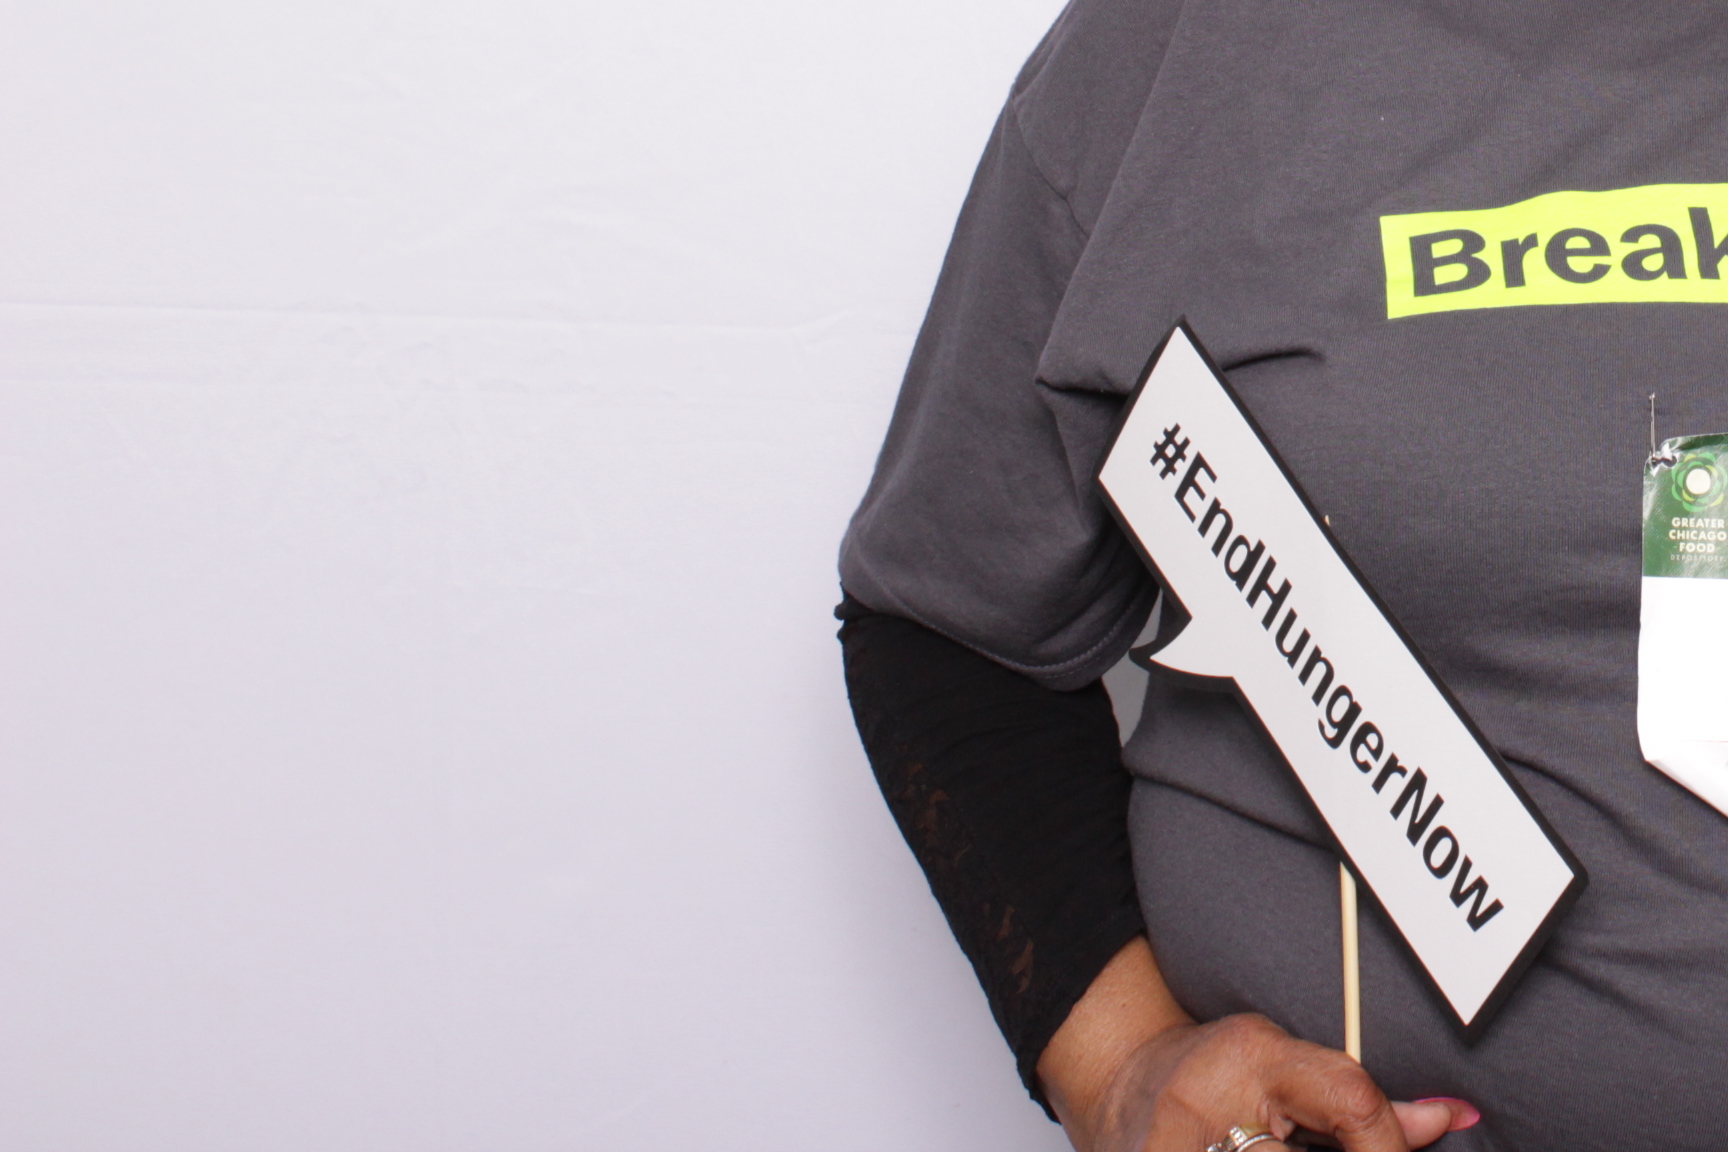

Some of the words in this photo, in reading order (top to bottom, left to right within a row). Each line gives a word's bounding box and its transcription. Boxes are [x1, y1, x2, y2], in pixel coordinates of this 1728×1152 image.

[1671, 516, 1725, 529] GREATER
[1668, 529, 1727, 542] CHICAGO
[1679, 542, 1715, 554] FOOD
[1149, 423, 1504, 932] #EndHungerNow
